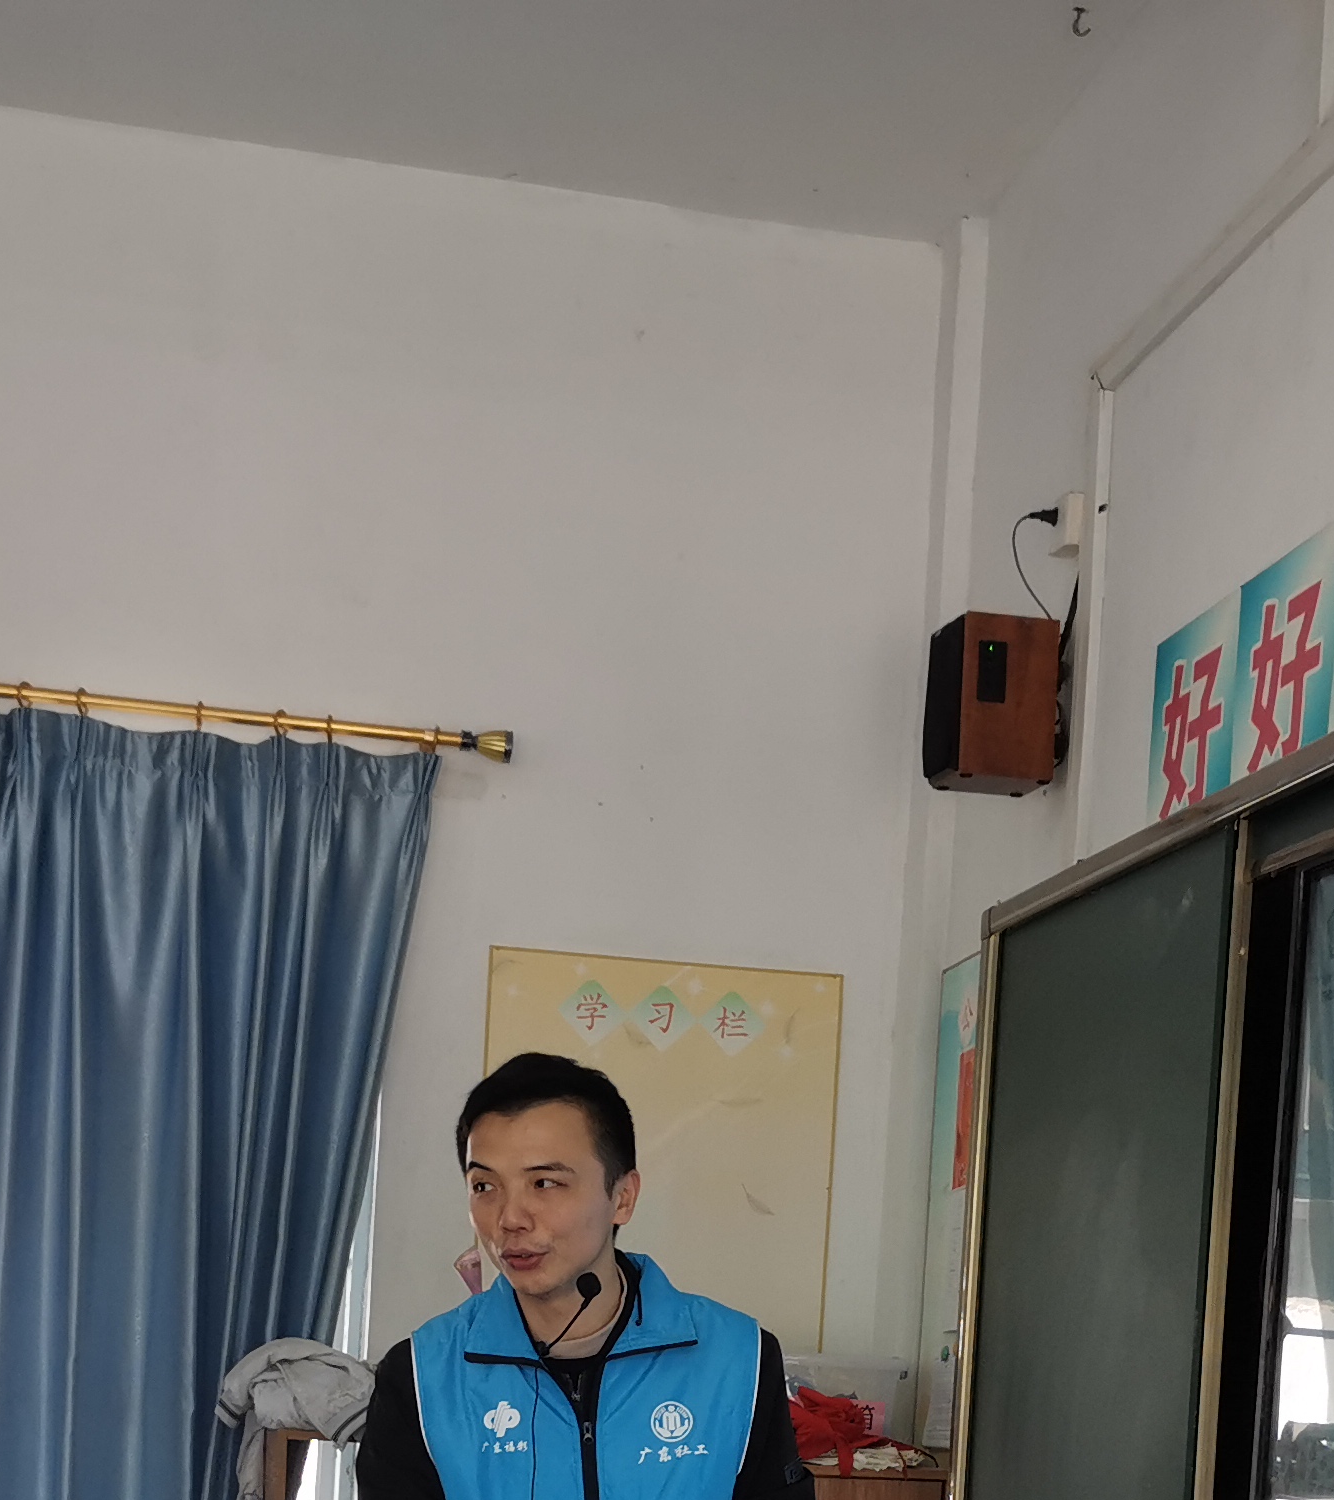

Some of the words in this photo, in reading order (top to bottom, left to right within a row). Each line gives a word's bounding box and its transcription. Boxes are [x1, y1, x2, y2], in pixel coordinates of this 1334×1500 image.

[575, 992, 750, 1039] 学习栏
[637, 1444, 709, 1465] 广东社工
